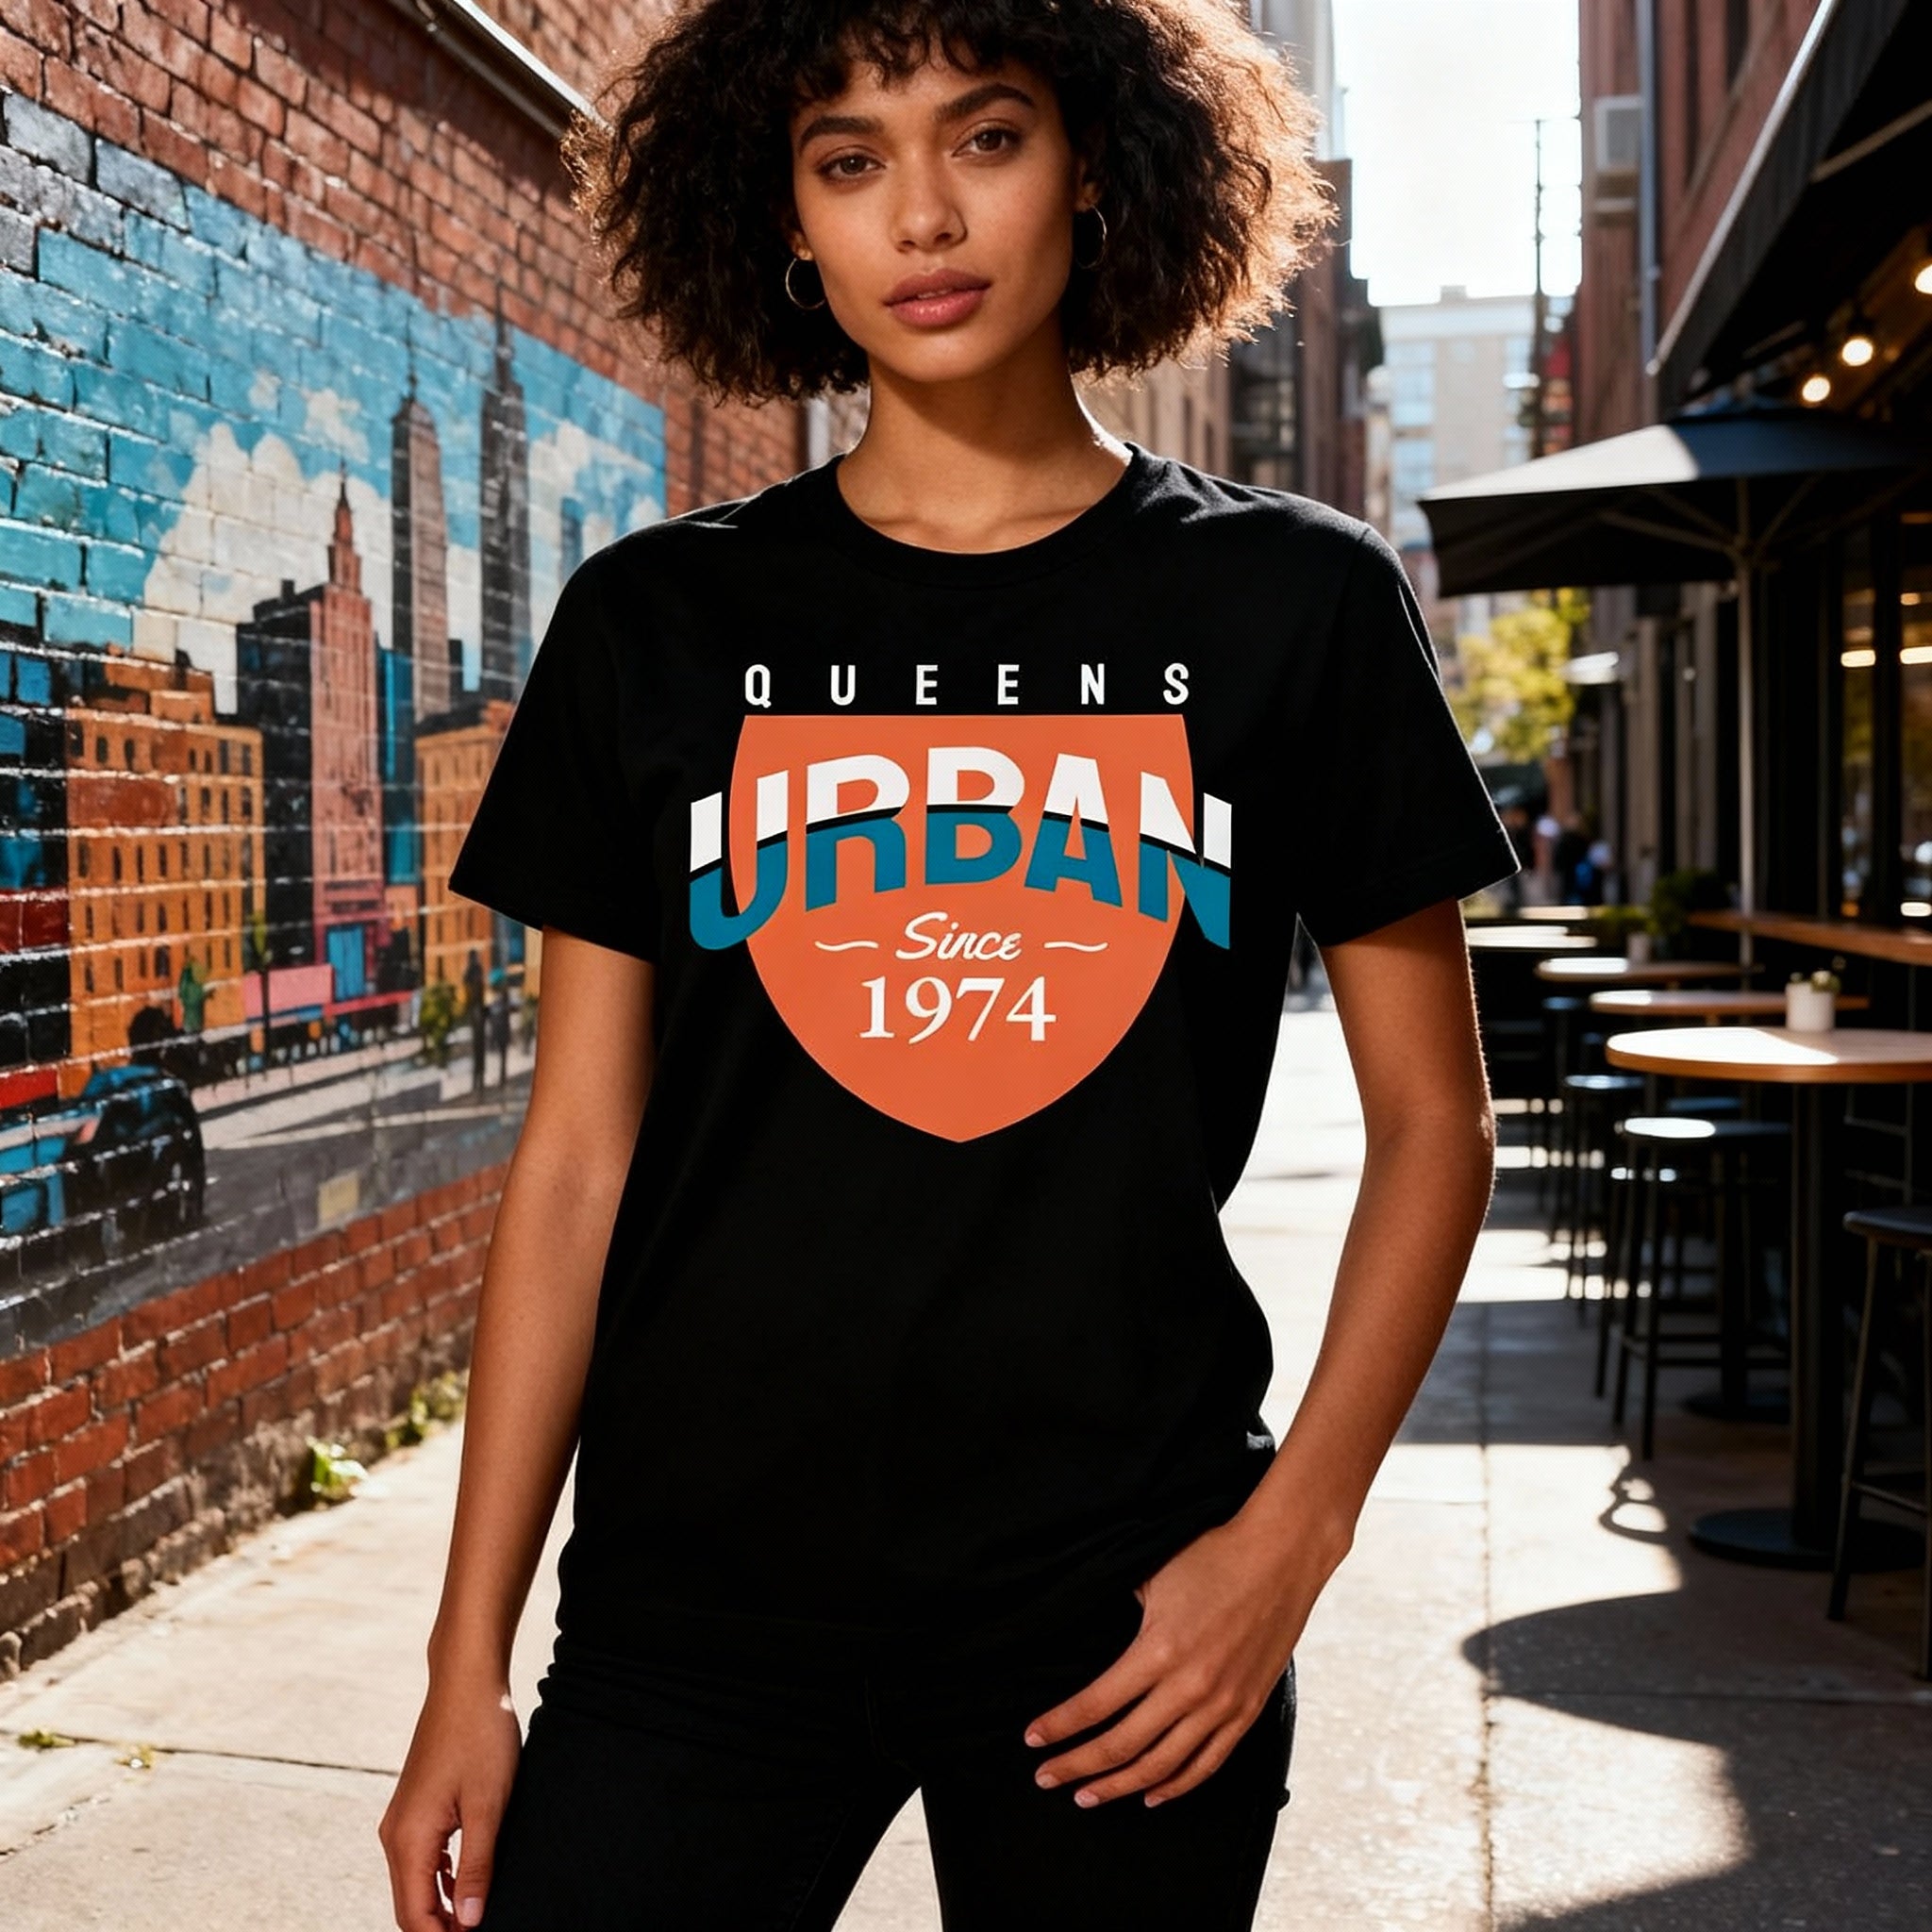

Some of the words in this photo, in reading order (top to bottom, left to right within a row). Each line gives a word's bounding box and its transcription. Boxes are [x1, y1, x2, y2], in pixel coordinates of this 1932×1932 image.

[744, 663, 1191, 708] QUEENS
[690, 746, 1232, 951] URBAN
[895, 911, 1022, 960] Since
[860, 977, 1056, 1042] 1974
